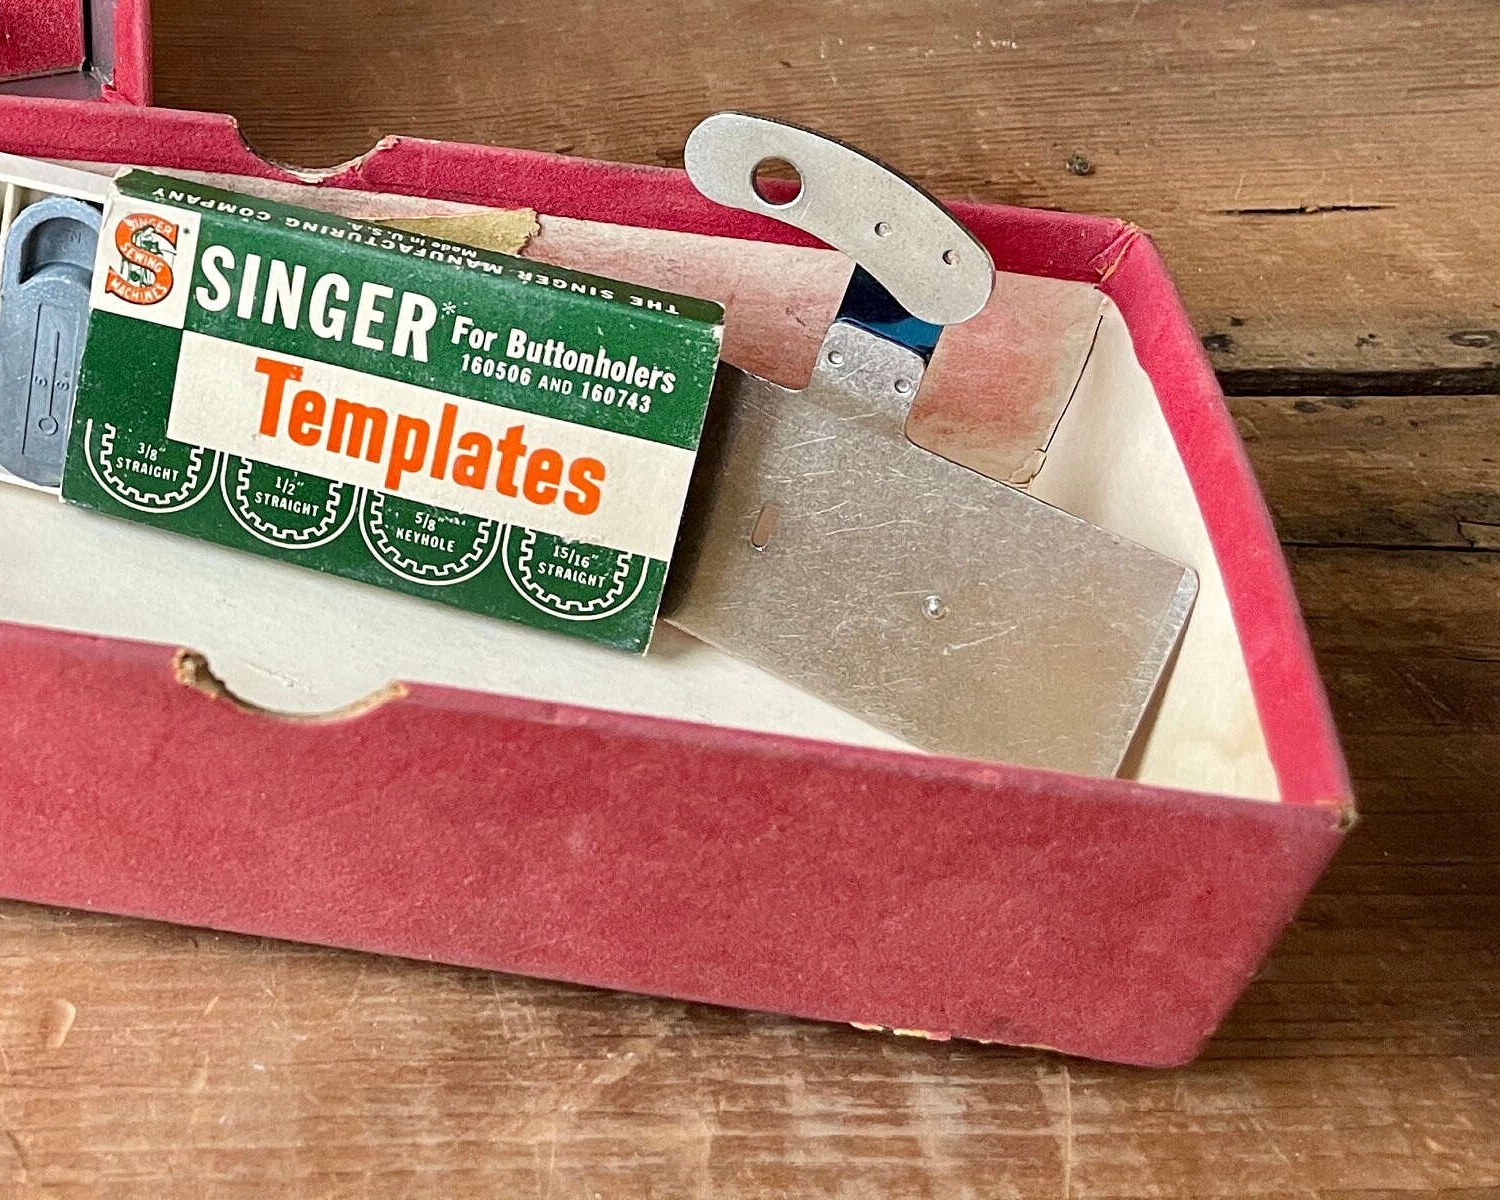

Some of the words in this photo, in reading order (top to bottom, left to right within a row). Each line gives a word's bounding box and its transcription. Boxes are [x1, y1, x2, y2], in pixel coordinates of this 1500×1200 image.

[152, 187, 271, 221] COMPANY
[128, 218, 173, 236] SINGER
[120, 242, 165, 273] SEWING
[285, 216, 504, 275] MANUFACTURING
[431, 239, 478, 259] Made
[110, 277, 168, 301] MACHINES
[517, 270, 615, 300] SINGER
[194, 244, 438, 363] SINGER
[629, 295, 680, 316] THE
[451, 315, 498, 351] For
[506, 328, 677, 394] Buttonholers
[461, 353, 532, 386] 160506
[537, 375, 574, 395] AND
[581, 381, 652, 414] 160743
[254, 356, 608, 516] Templates
[115, 456, 180, 483] STRAIGHT
[254, 491, 320, 518] STRAIGHT
[395, 526, 456, 553] KEYHOLE
[537, 561, 606, 588] STRAIGHT
